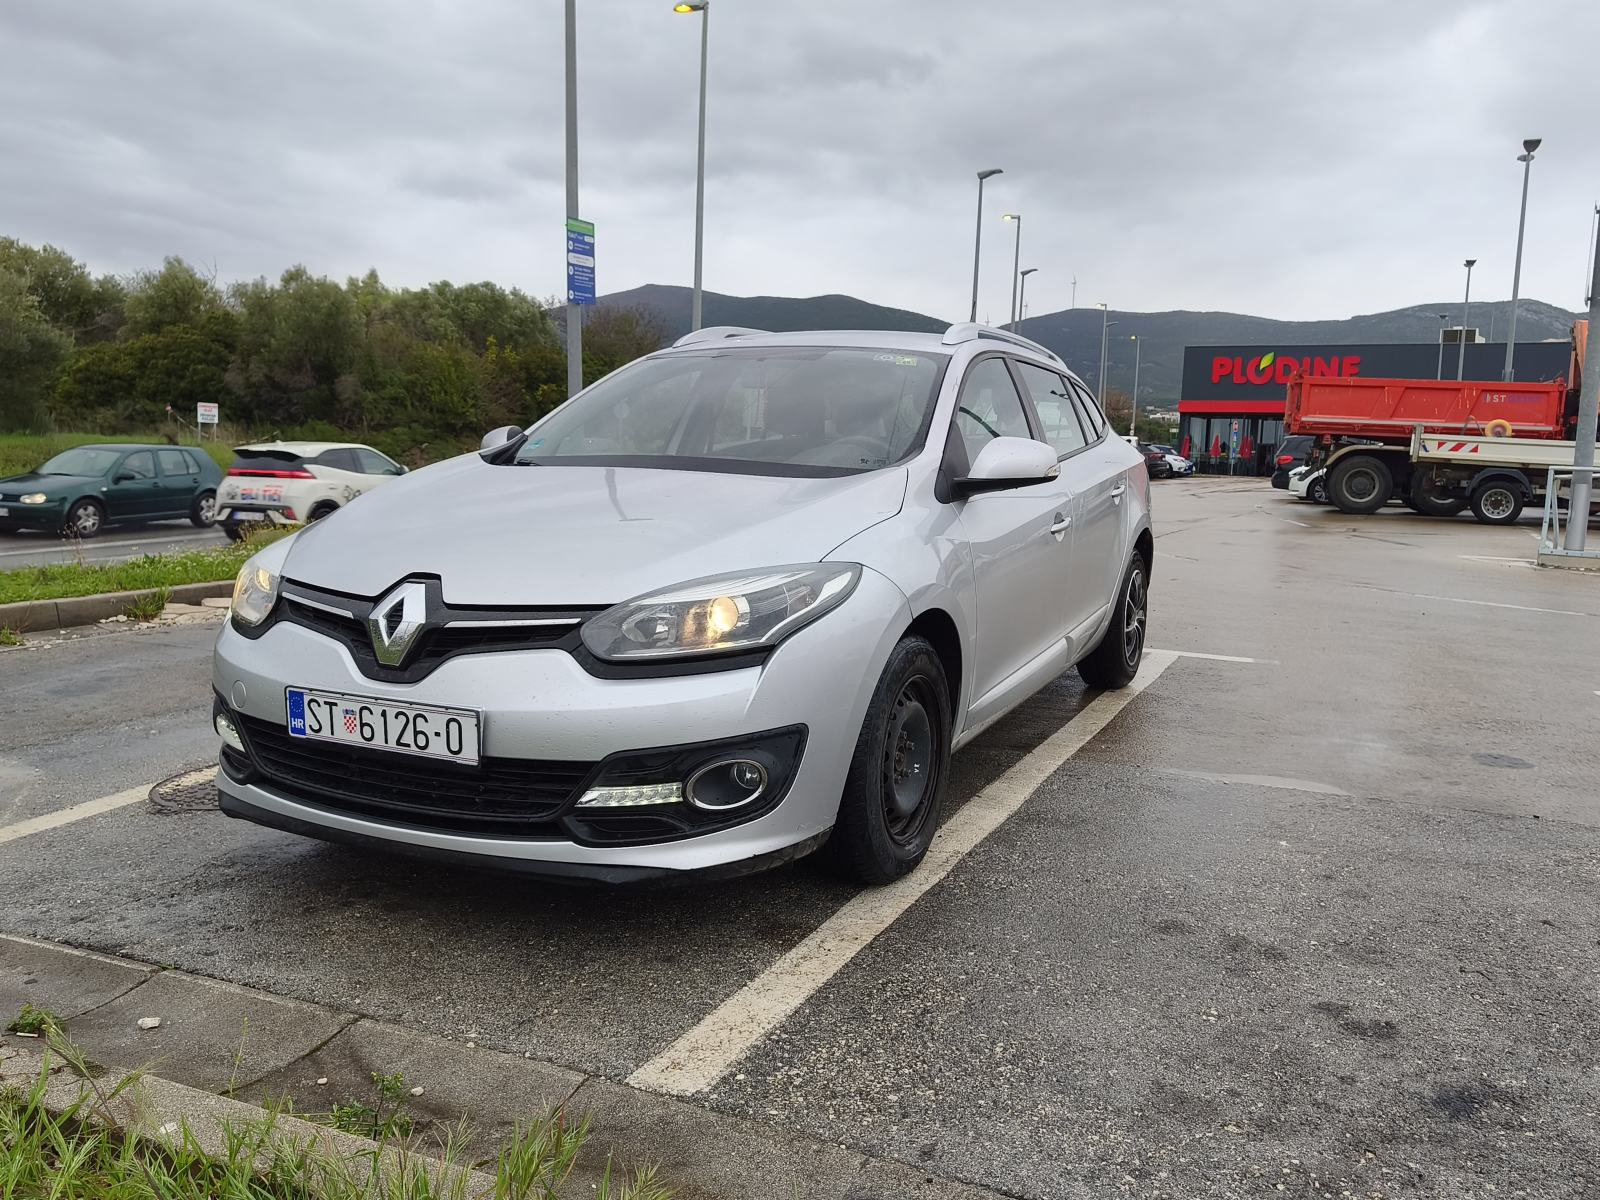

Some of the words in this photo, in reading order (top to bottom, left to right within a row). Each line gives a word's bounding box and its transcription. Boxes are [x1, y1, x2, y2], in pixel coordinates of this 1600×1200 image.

[1211, 355, 1361, 385] PLODINE
[291, 717, 304, 730] HR
[307, 698, 338, 736] ST
